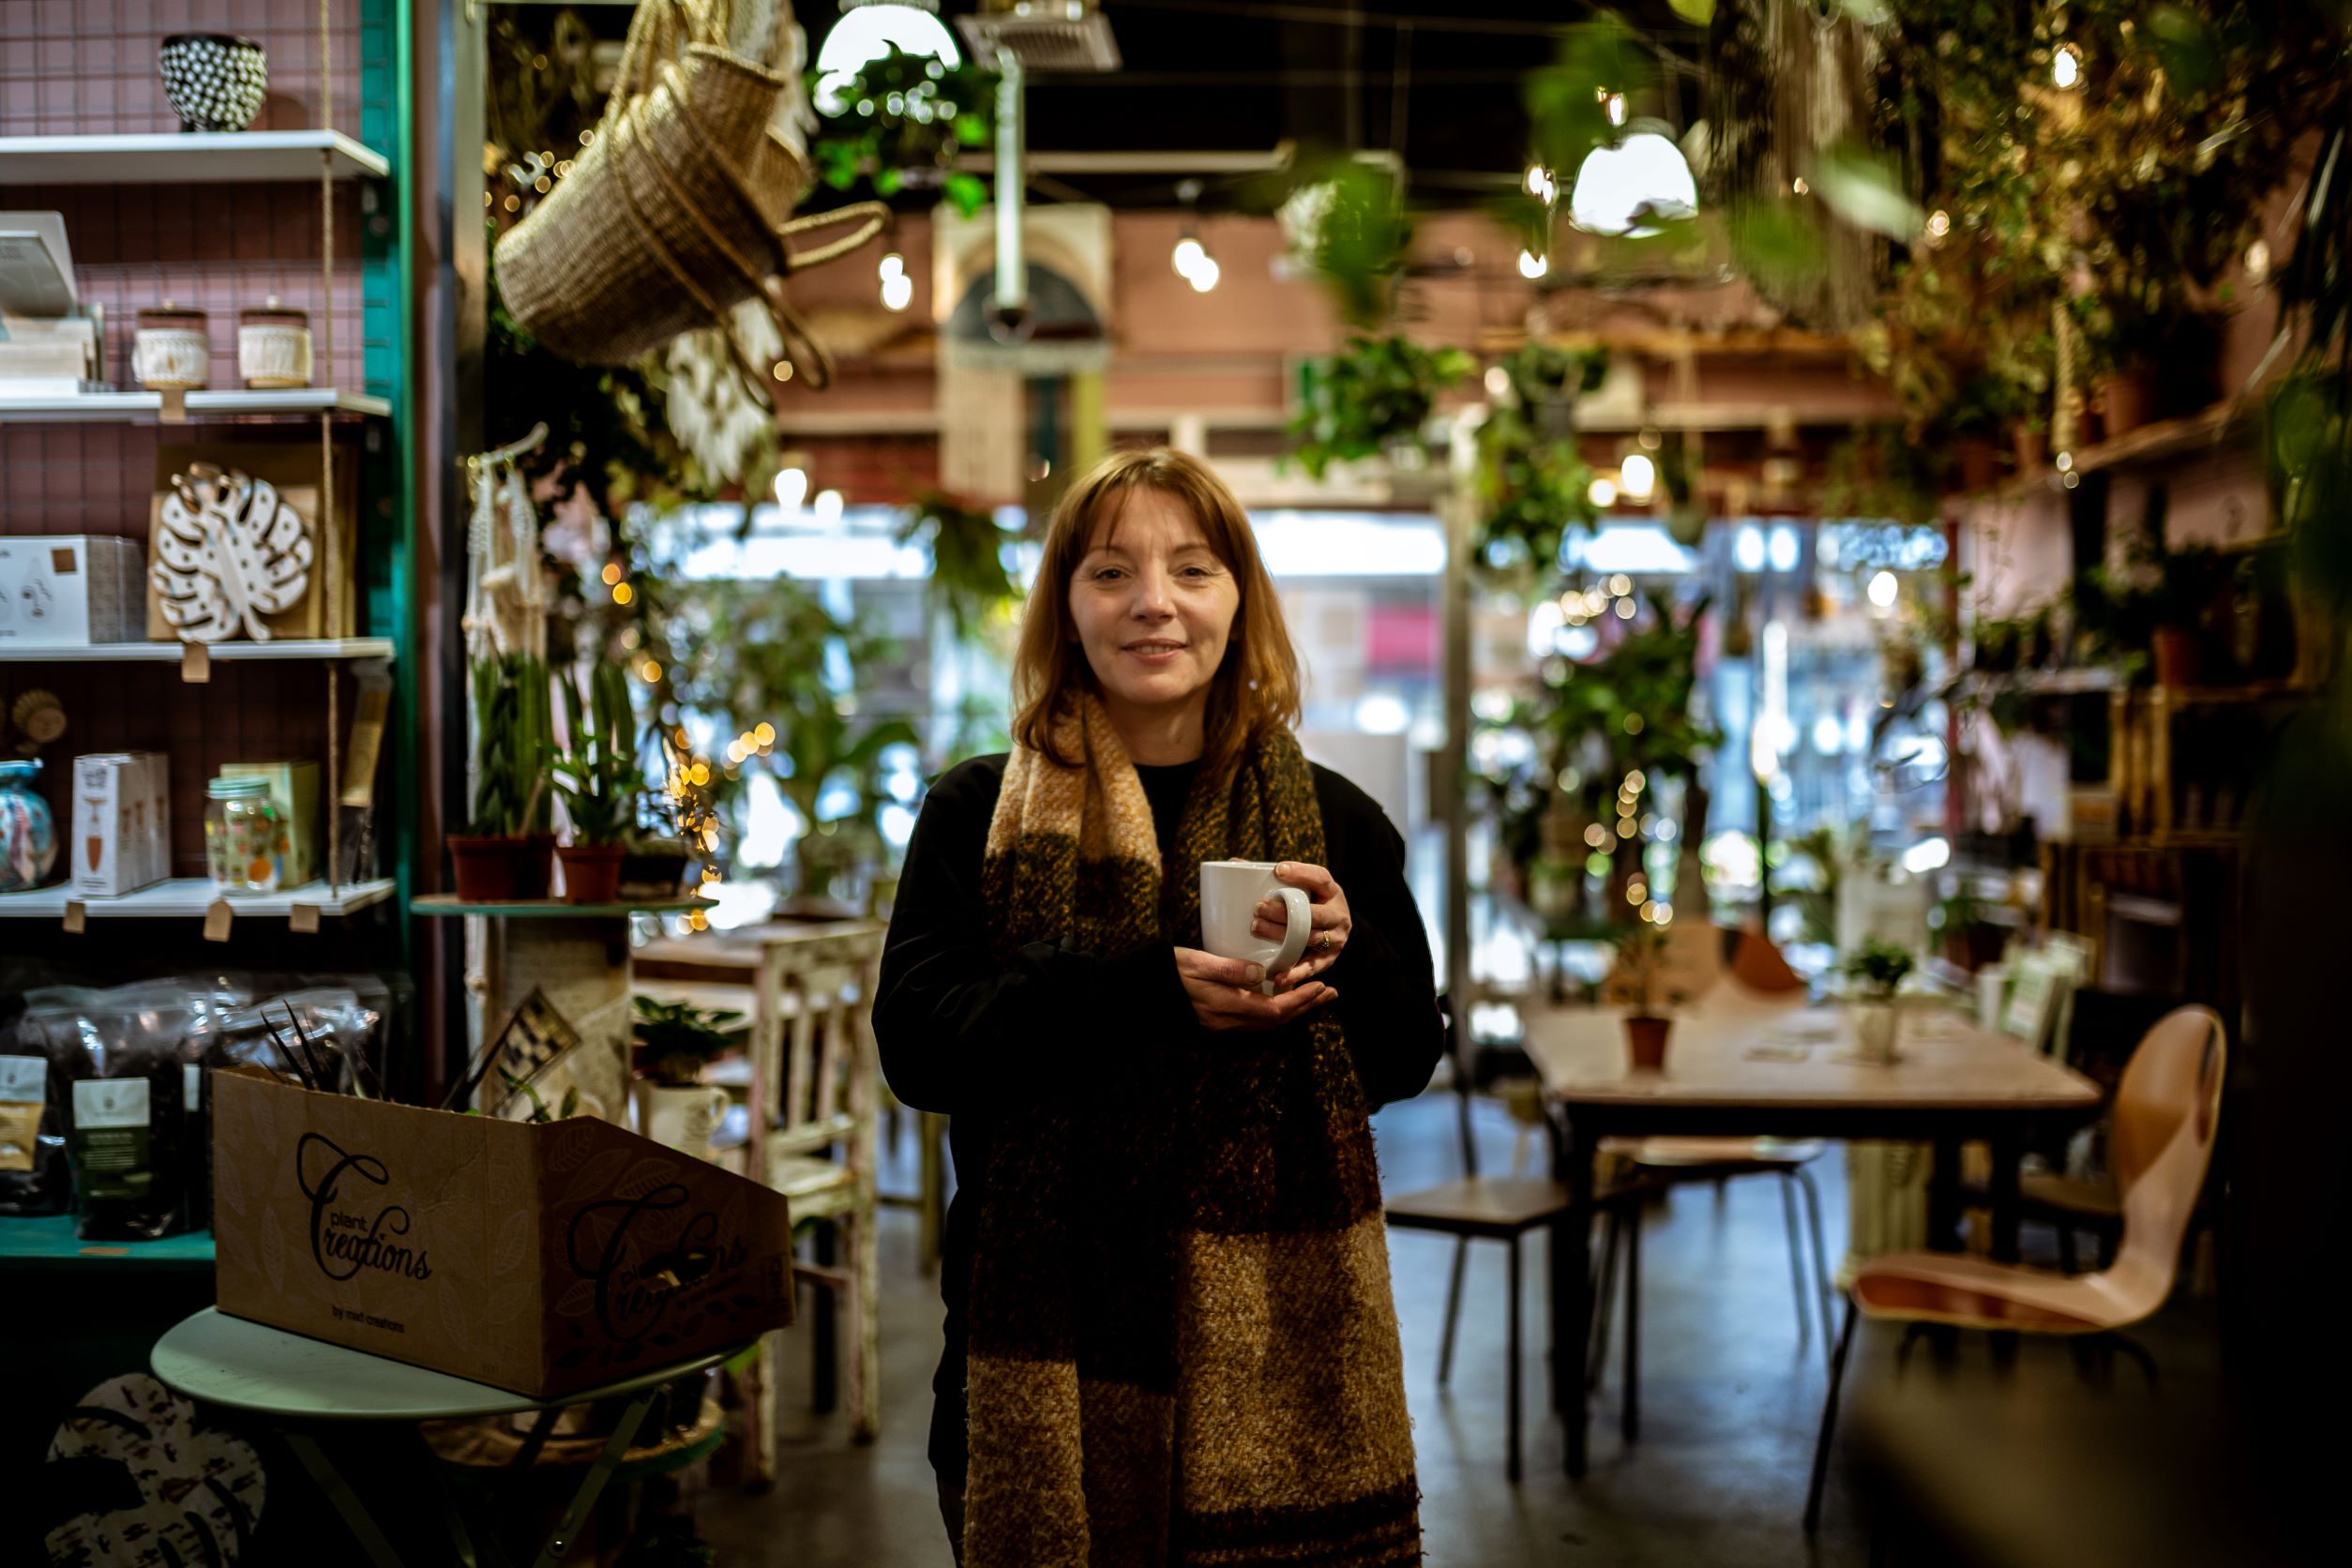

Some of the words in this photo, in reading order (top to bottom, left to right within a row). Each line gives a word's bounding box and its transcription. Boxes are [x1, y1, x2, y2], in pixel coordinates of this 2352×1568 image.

[296, 1132, 432, 1281] Creations
[330, 1211, 368, 1232] plant
[331, 1304, 343, 1321] by
[366, 1315, 405, 1334] creations
